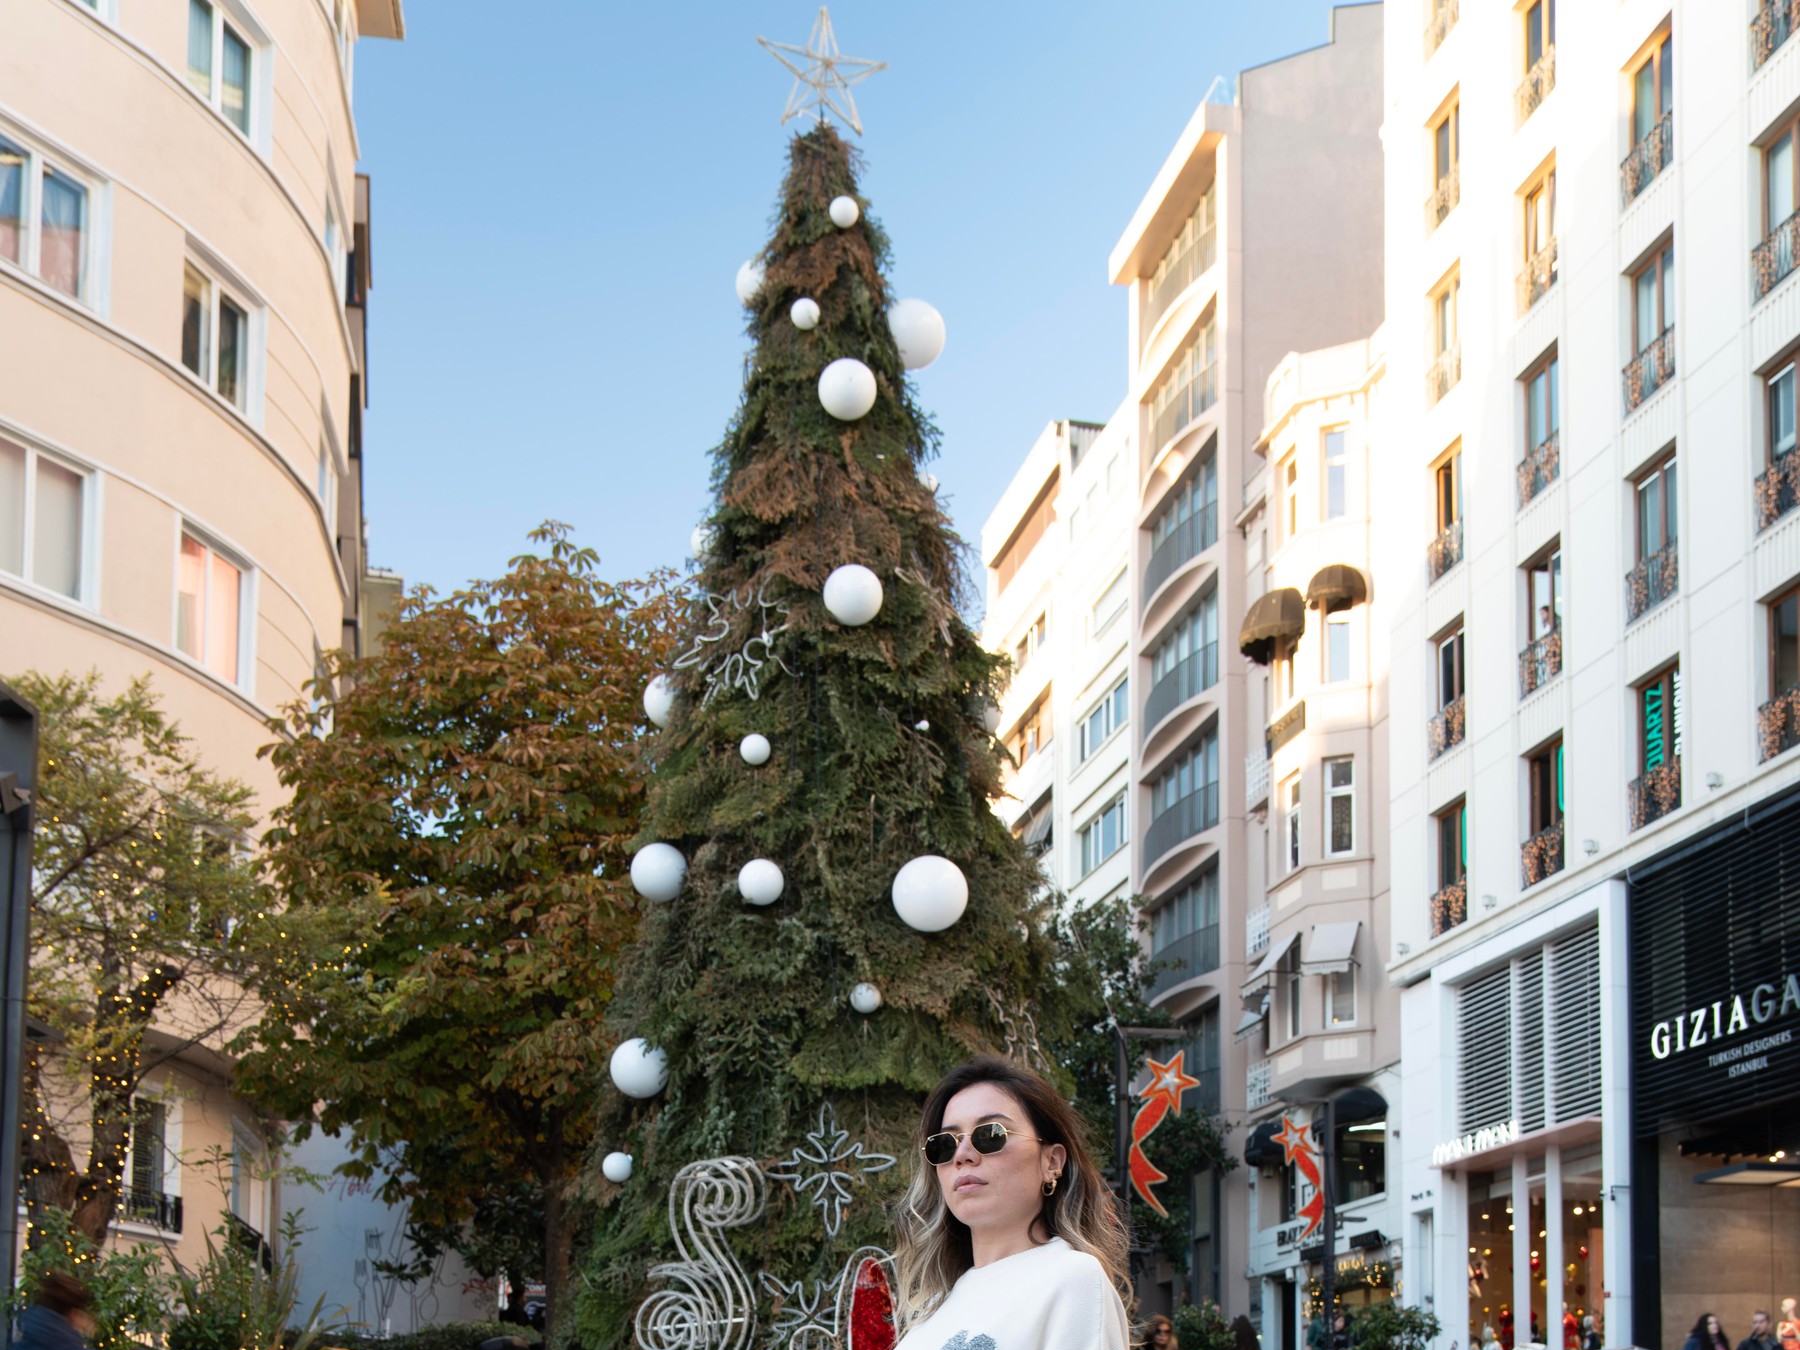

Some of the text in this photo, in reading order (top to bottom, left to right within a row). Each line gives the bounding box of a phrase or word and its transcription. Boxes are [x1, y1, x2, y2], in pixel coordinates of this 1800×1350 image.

[1645, 681, 1664, 772] QUARTZ
[1708, 1030, 1793, 1068] TURKISH DESIGNERS
[1728, 1055, 1769, 1079] ISTANBUL
